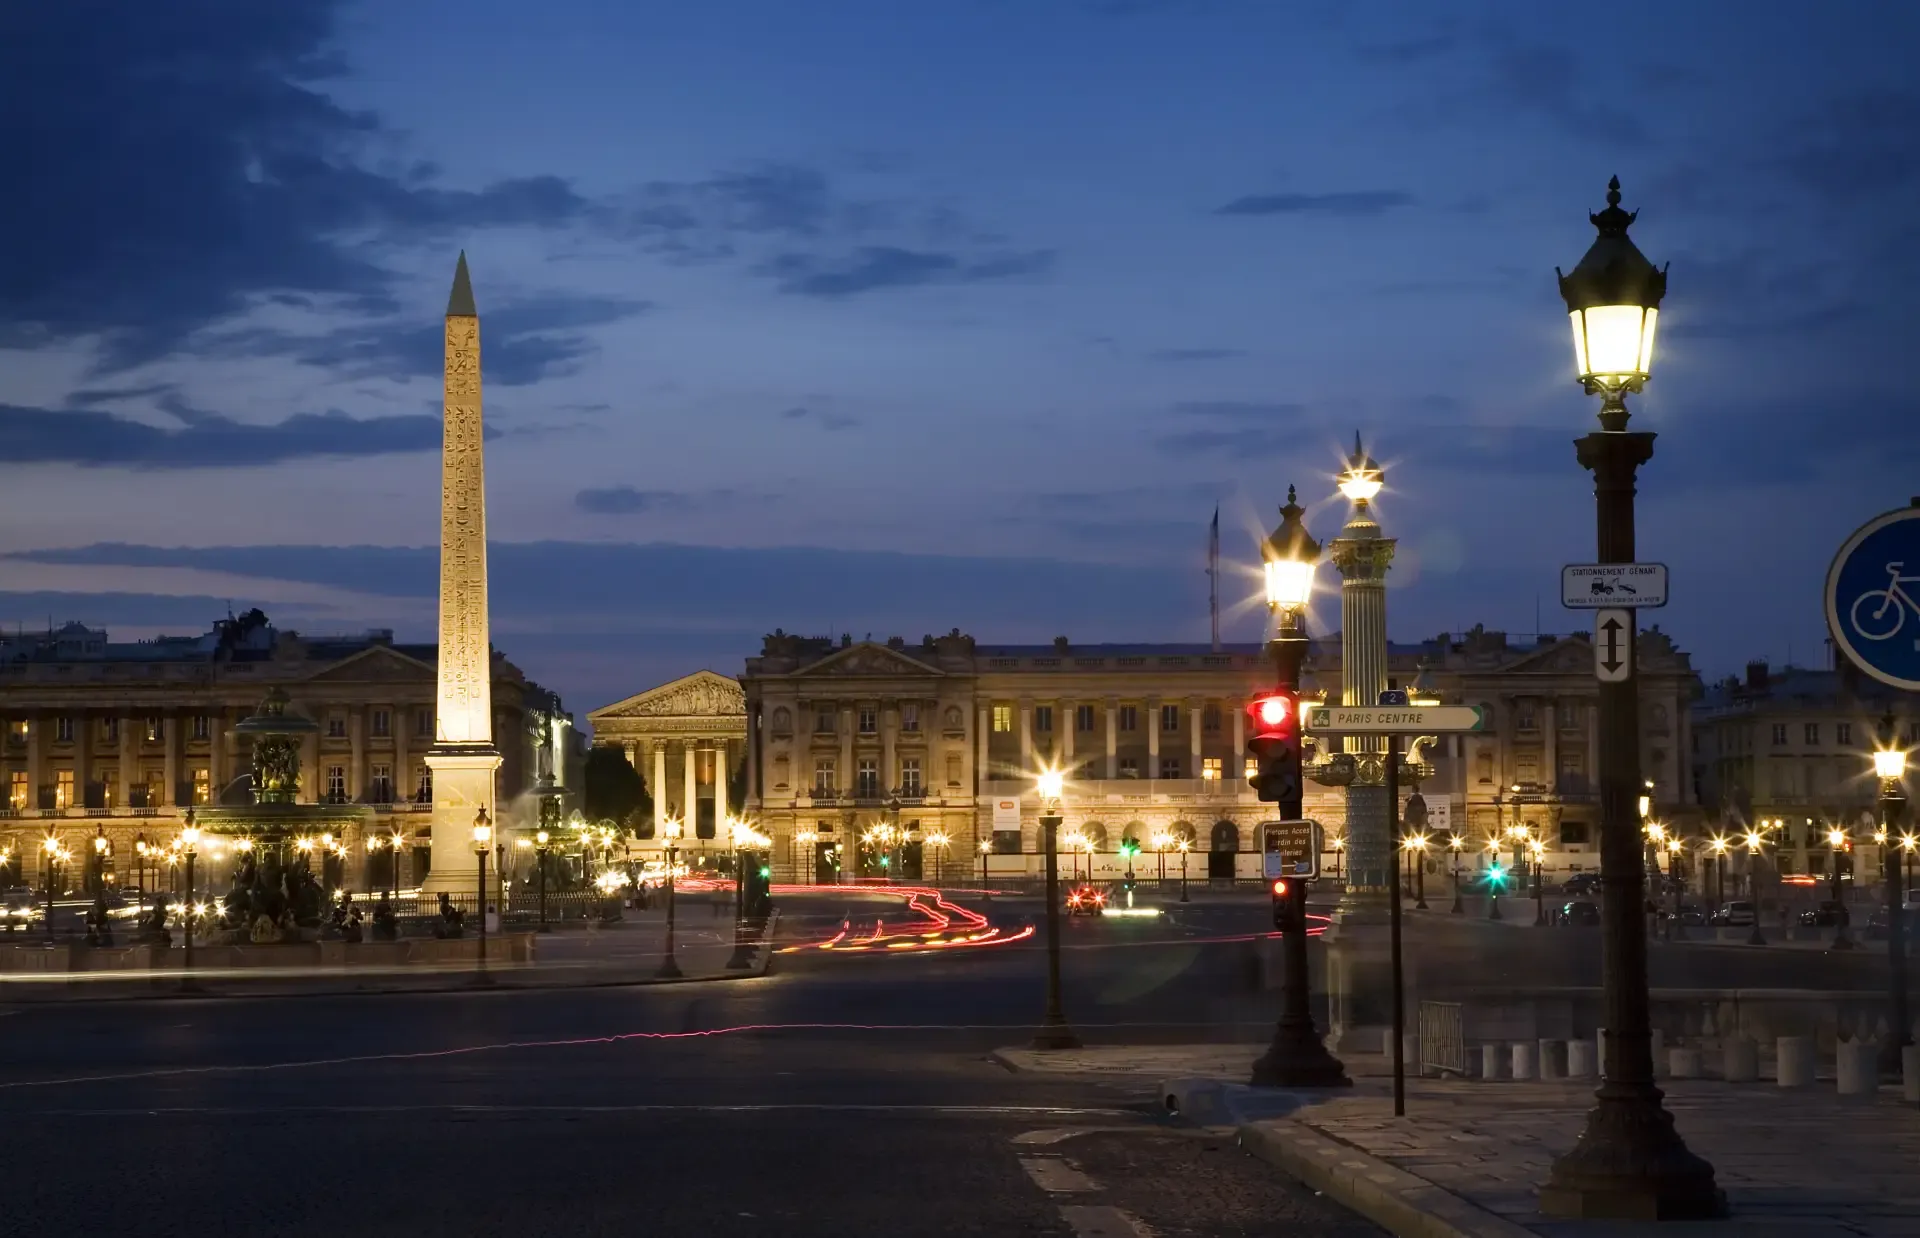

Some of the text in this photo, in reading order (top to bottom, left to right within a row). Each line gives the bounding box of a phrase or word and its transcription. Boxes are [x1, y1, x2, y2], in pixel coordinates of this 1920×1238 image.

[1572, 568, 1625, 576] STATIONNEMENT
[1389, 693, 1397, 703] 2
[1338, 714, 1423, 724] PARIS CENTRE
